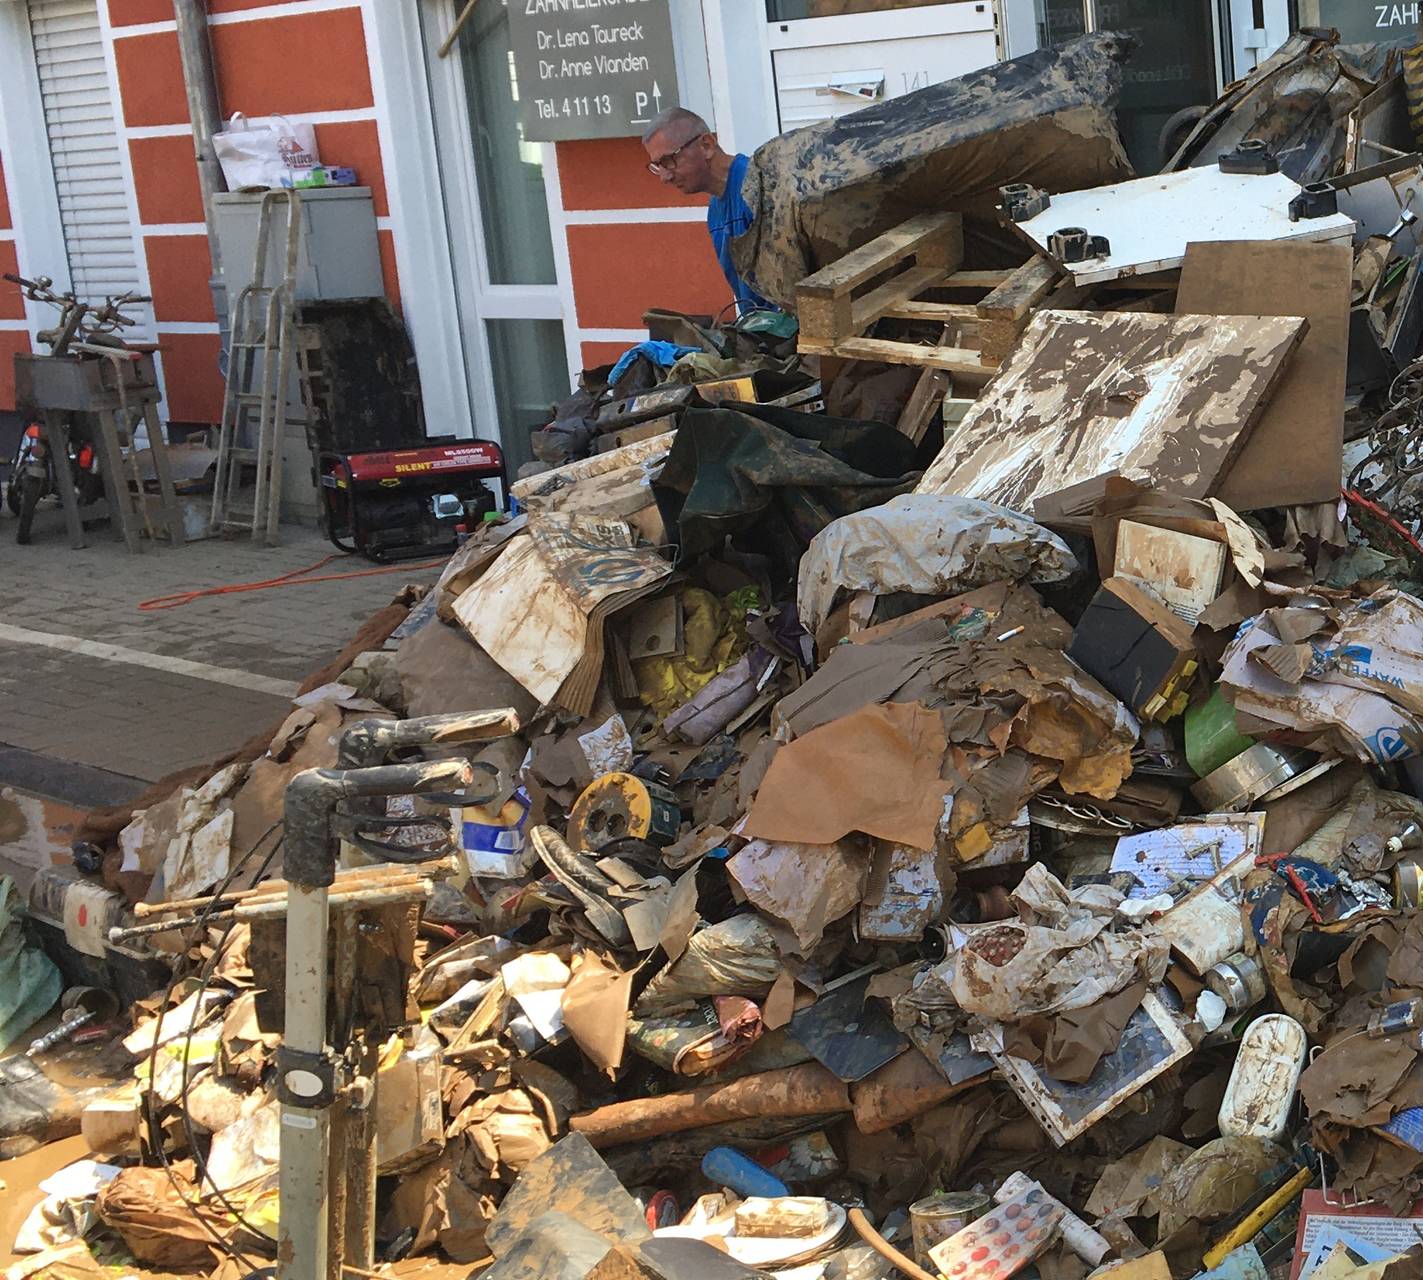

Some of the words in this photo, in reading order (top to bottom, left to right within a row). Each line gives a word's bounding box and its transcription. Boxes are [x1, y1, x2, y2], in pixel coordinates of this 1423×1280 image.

[536, 30, 556, 50] Dr.
[557, 29, 589, 48] Lena
[591, 20, 644, 45] Taureck
[539, 60, 558, 79] Dr.
[560, 58, 592, 78] Anne
[594, 52, 649, 74] Vianden
[534, 98, 559, 119] Tel.
[562, 98, 571, 117] 4
[573, 97, 589, 116] 11
[593, 94, 612, 114] 13
[635, 91, 648, 116] P
[394, 462, 432, 472] SILENT
